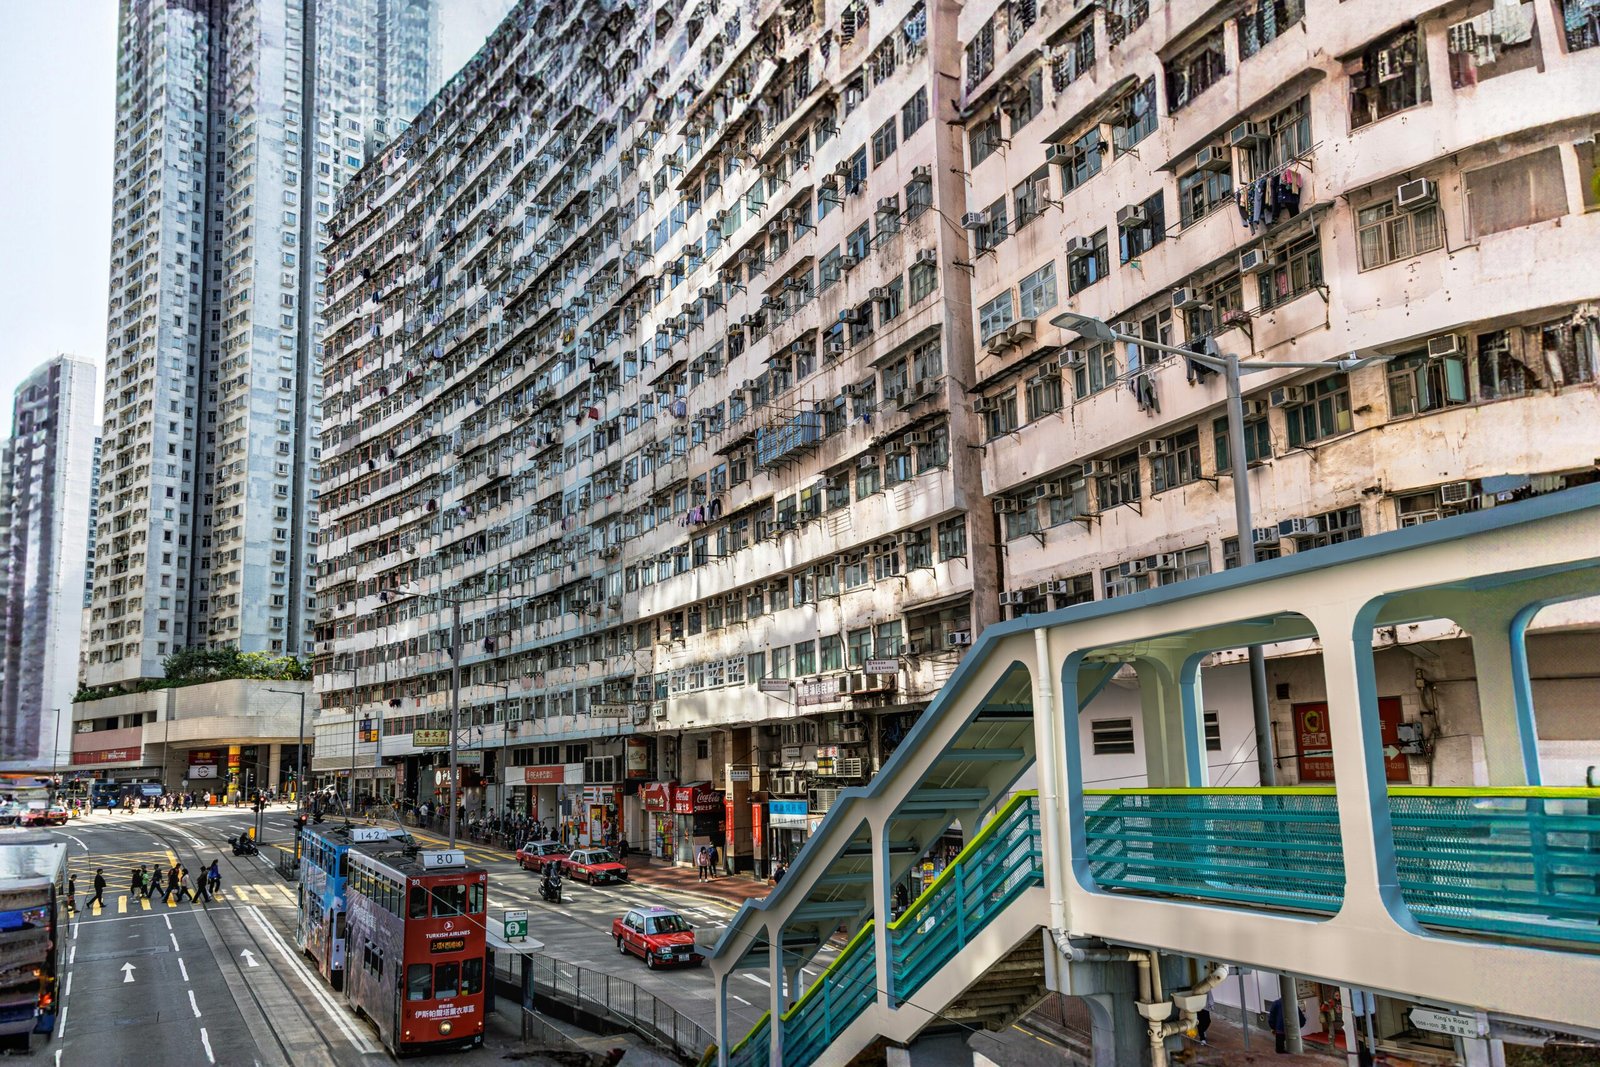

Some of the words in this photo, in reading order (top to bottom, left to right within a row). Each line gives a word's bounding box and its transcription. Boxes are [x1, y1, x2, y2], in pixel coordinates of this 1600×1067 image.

[436, 854, 453, 864] 80
[425, 931, 449, 939] TURKISH
[449, 929, 471, 937] AIRLINES
[1433, 1014, 1452, 1022] King's
[1453, 1017, 1469, 1026] Road
[1440, 1023, 1465, 1035] 英皇道
